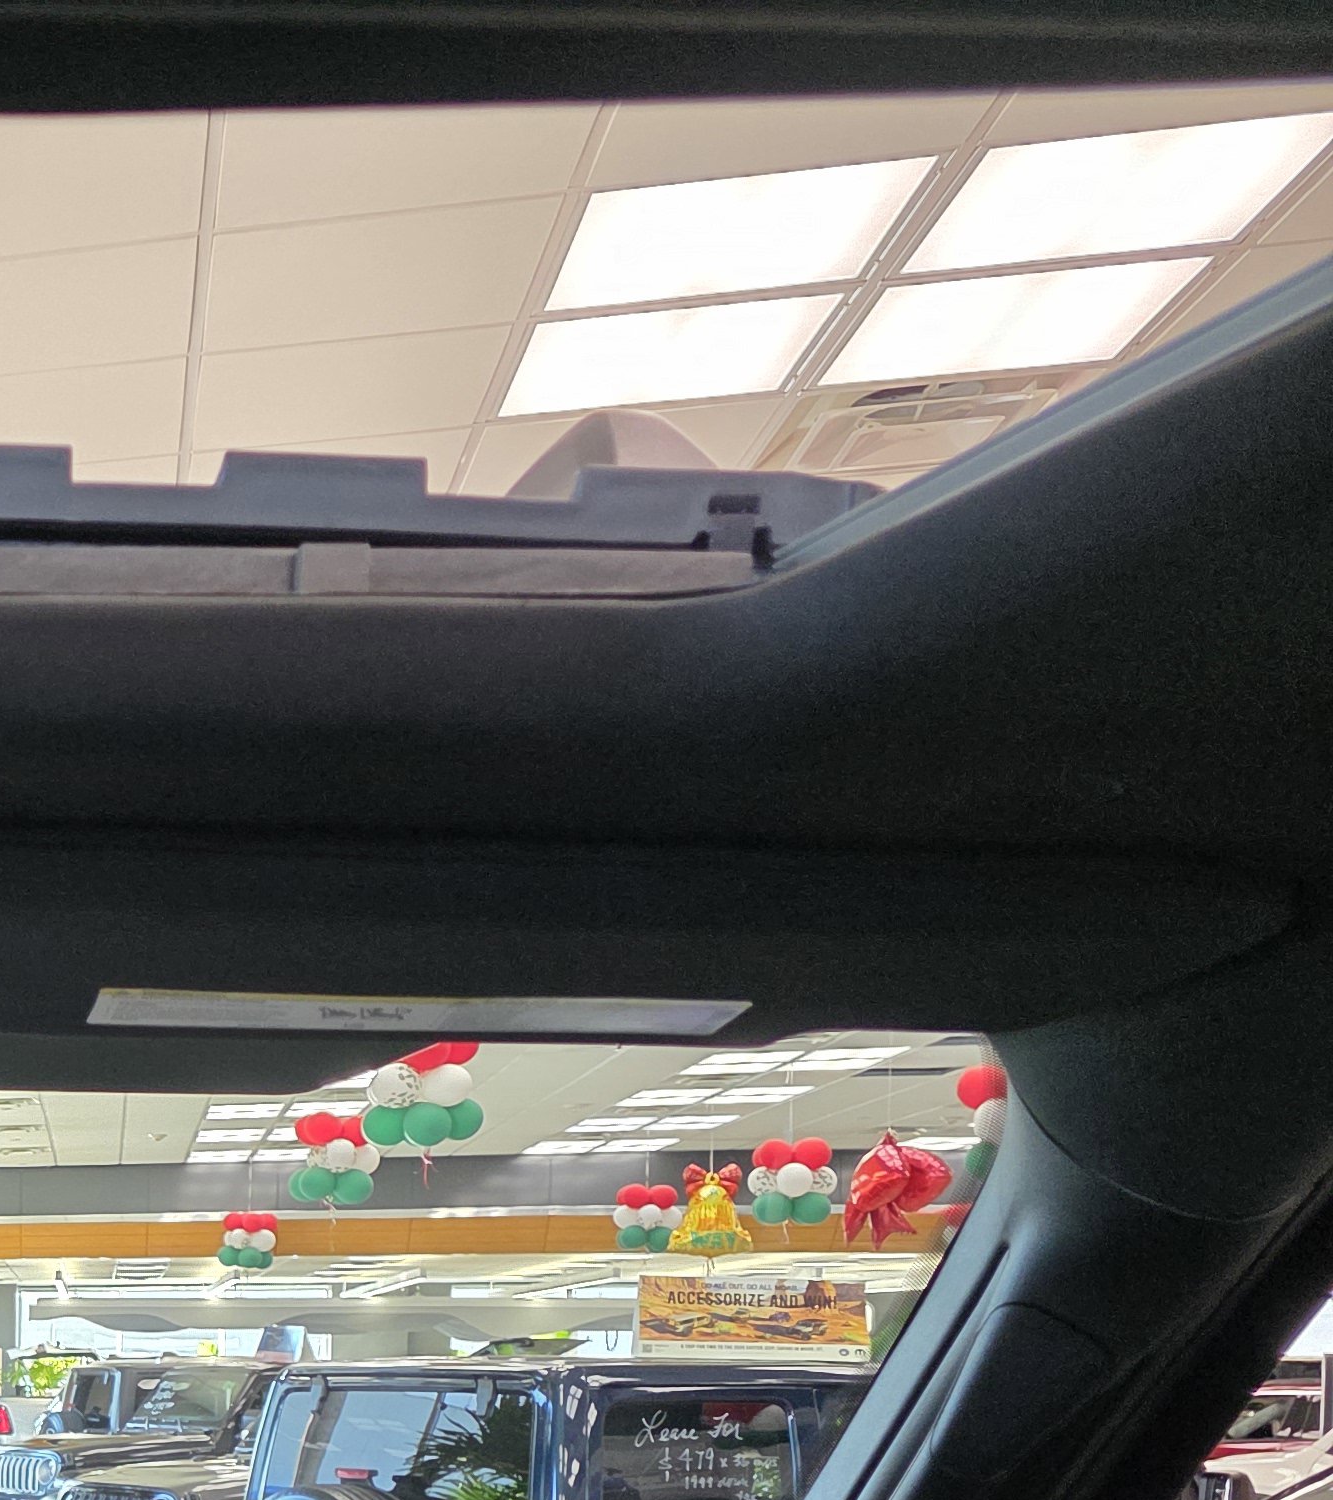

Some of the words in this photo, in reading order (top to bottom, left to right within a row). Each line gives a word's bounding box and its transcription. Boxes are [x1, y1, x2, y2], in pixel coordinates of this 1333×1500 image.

[667, 1291, 765, 1308] ACCESSORIZE
[769, 1294, 798, 1308] AND
[805, 1294, 837, 1310] WIN!
[635, 1410, 699, 1447] Lease
[707, 1413, 743, 1440] For
[685, 1476, 713, 1490] 1999
